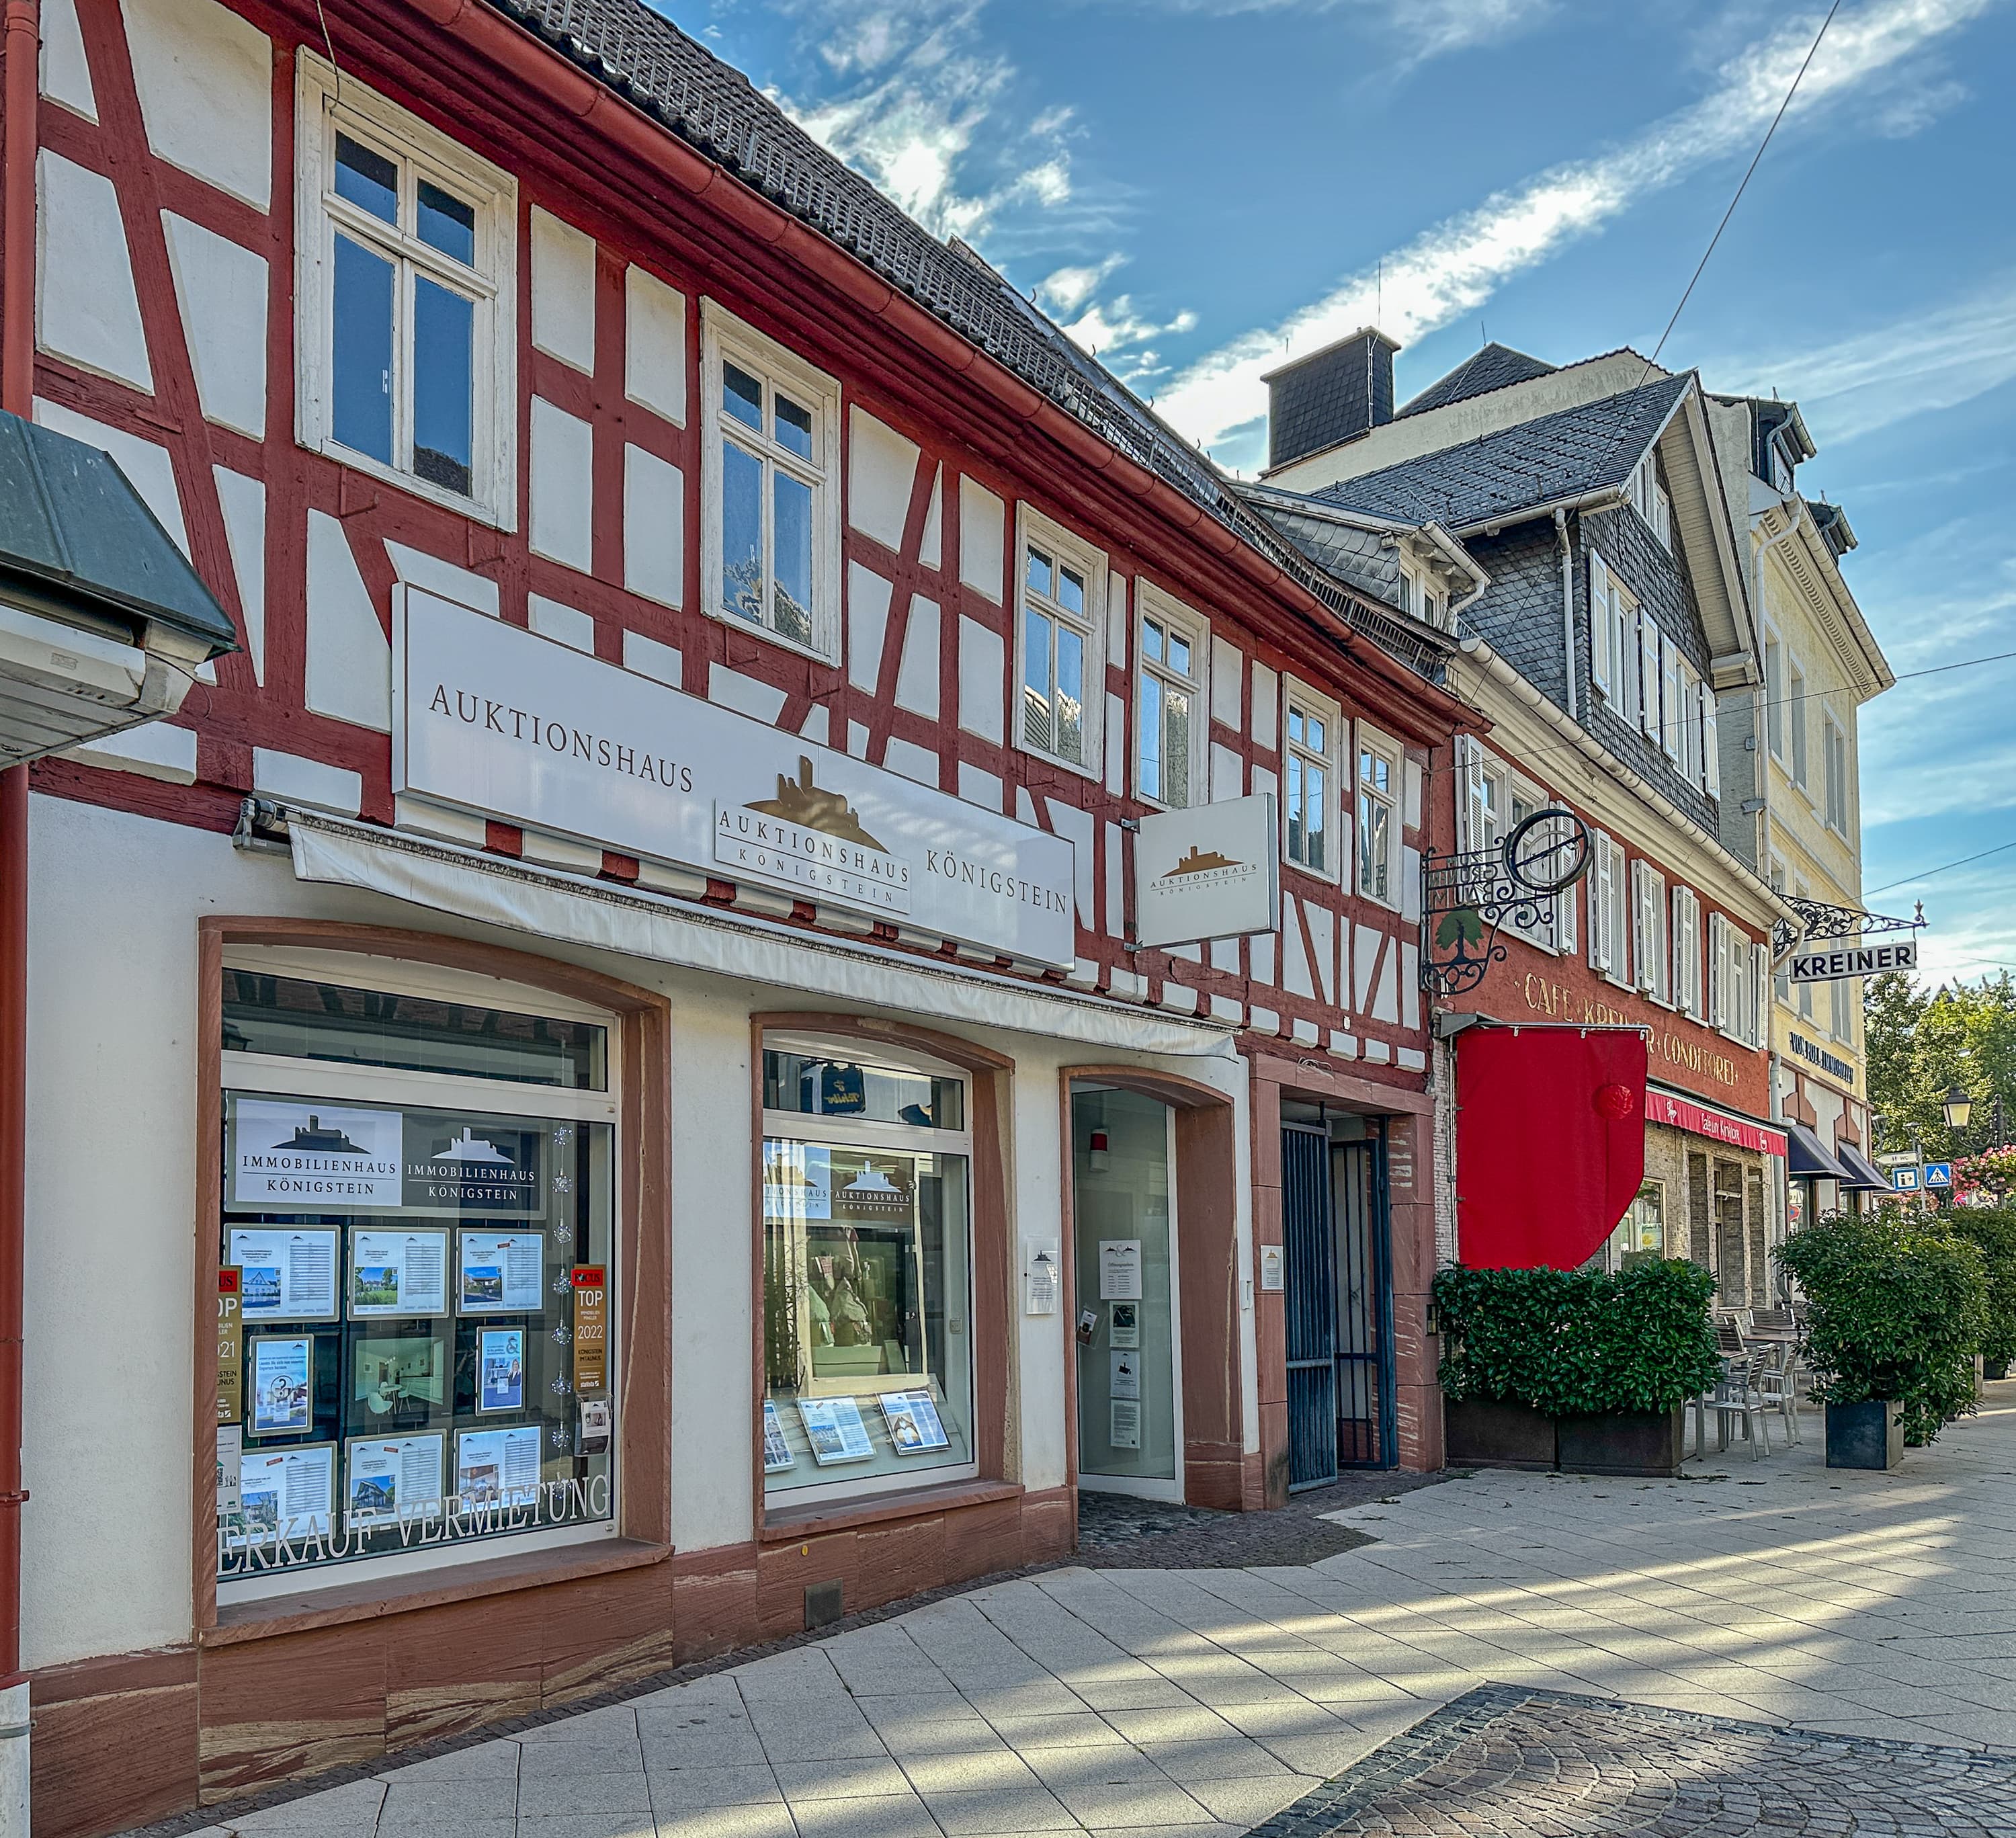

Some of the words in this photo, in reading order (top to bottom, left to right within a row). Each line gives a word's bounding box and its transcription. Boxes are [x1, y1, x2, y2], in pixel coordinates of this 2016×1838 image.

[429, 683, 693, 794] AUKTIONSHAUS
[926, 848, 1067, 915] KÖNIGSTEIN
[719, 809, 909, 884] AUKTIONSHAUS
[738, 847, 892, 903] KÖNIGSTEIN
[1150, 864, 1257, 888] AUKTIONSHAUS
[1160, 877, 1247, 896] KÖNIGSTEIN
[1793, 946, 1912, 978] KREINER
[1583, 997, 1654, 1054] KRER
[1664, 1032, 1734, 1087] CONDITOREI
[243, 1155, 396, 1174] IMMOBILIENHAUS
[407, 1164, 536, 1181] IMMOBILIENHAUS
[266, 1177, 375, 1195] KÖNIGSTEIN
[428, 1183, 518, 1200] KÖNIGSTEIN
[766, 1187, 827, 1197] TIONSHAUS
[765, 1199, 819, 1208] NIGSTEIN
[835, 1191, 910, 1202] AUKTIONSHAUS
[843, 1204, 904, 1213] KÖNIGSTEIN
[577, 1290, 603, 1307] TOP
[577, 1325, 603, 1339] 2022
[218, 1341, 235, 1358] 21
[217, 1378, 235, 1386] UNUS
